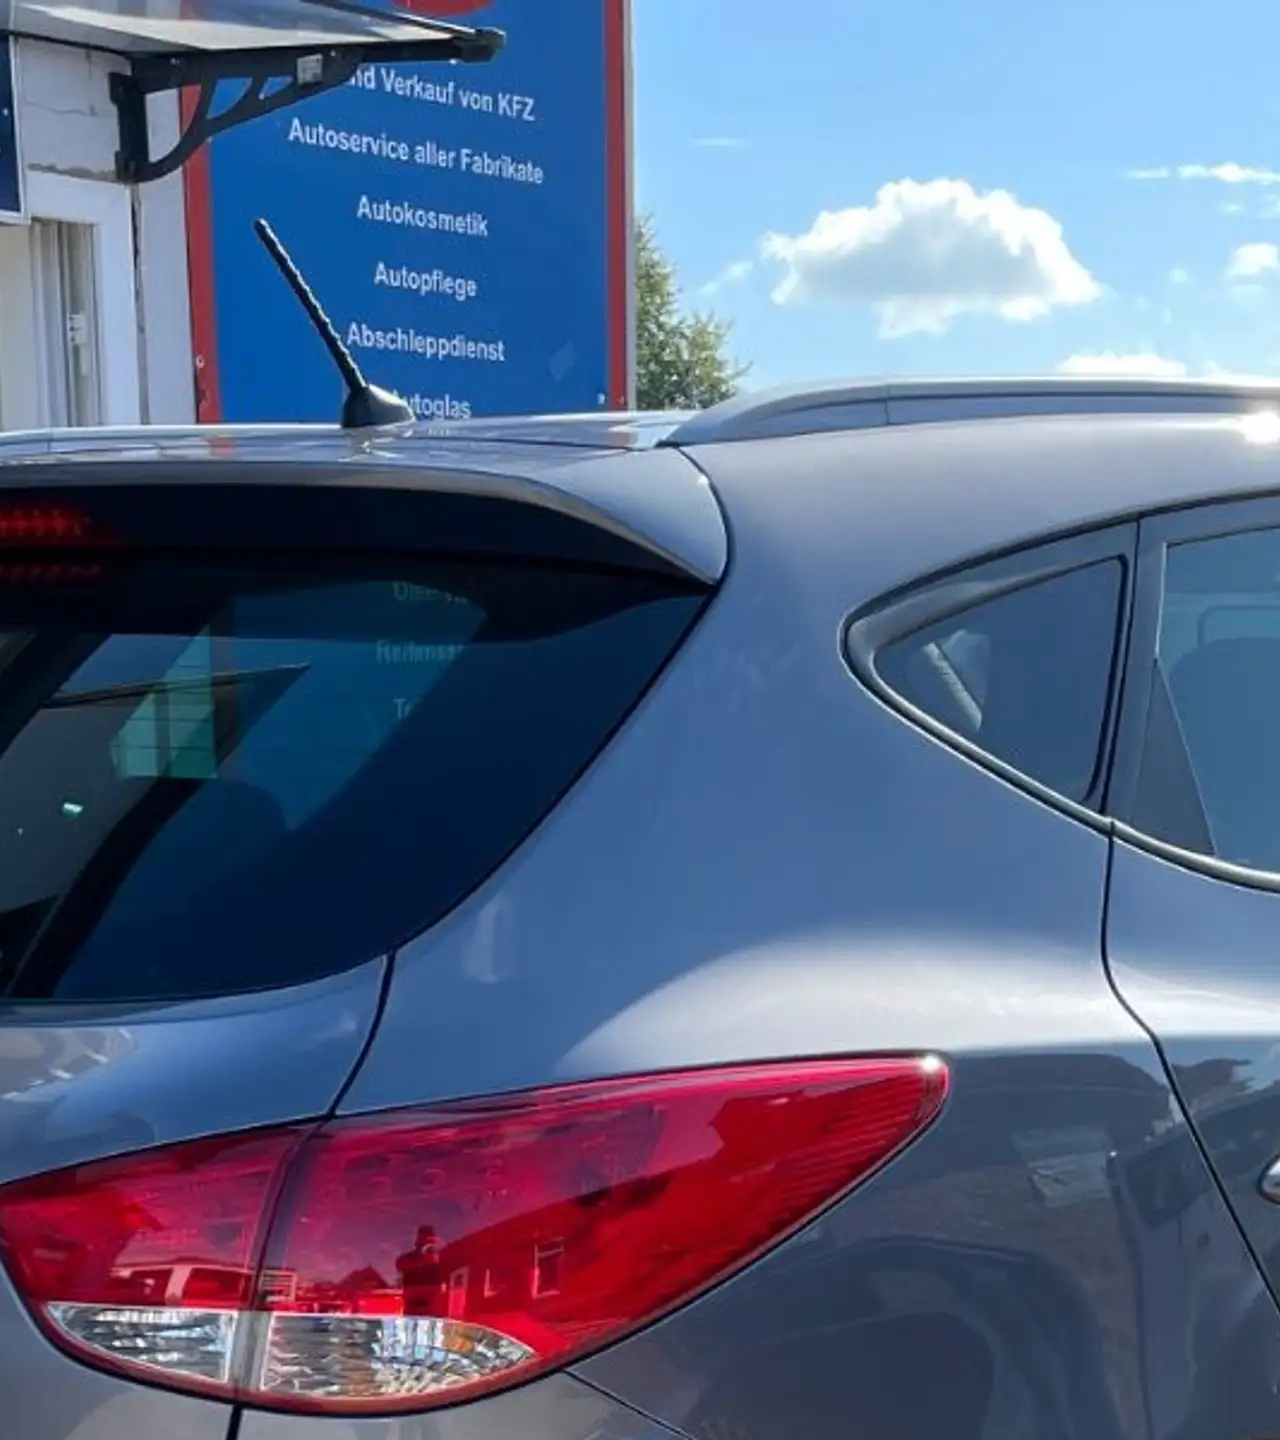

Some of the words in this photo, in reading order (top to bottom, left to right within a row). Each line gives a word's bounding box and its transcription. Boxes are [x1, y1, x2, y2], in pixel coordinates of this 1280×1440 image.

[380, 68, 455, 105] Verkauf
[459, 88, 493, 115] von
[498, 94, 536, 121] KFZ
[288, 117, 410, 162] Autoservice
[414, 141, 456, 168] aller
[460, 148, 545, 185] Fabrikate
[356, 195, 488, 237] Autokosmetik
[373, 261, 478, 301] Autopflege
[347, 321, 505, 363] Abschleppdienst
